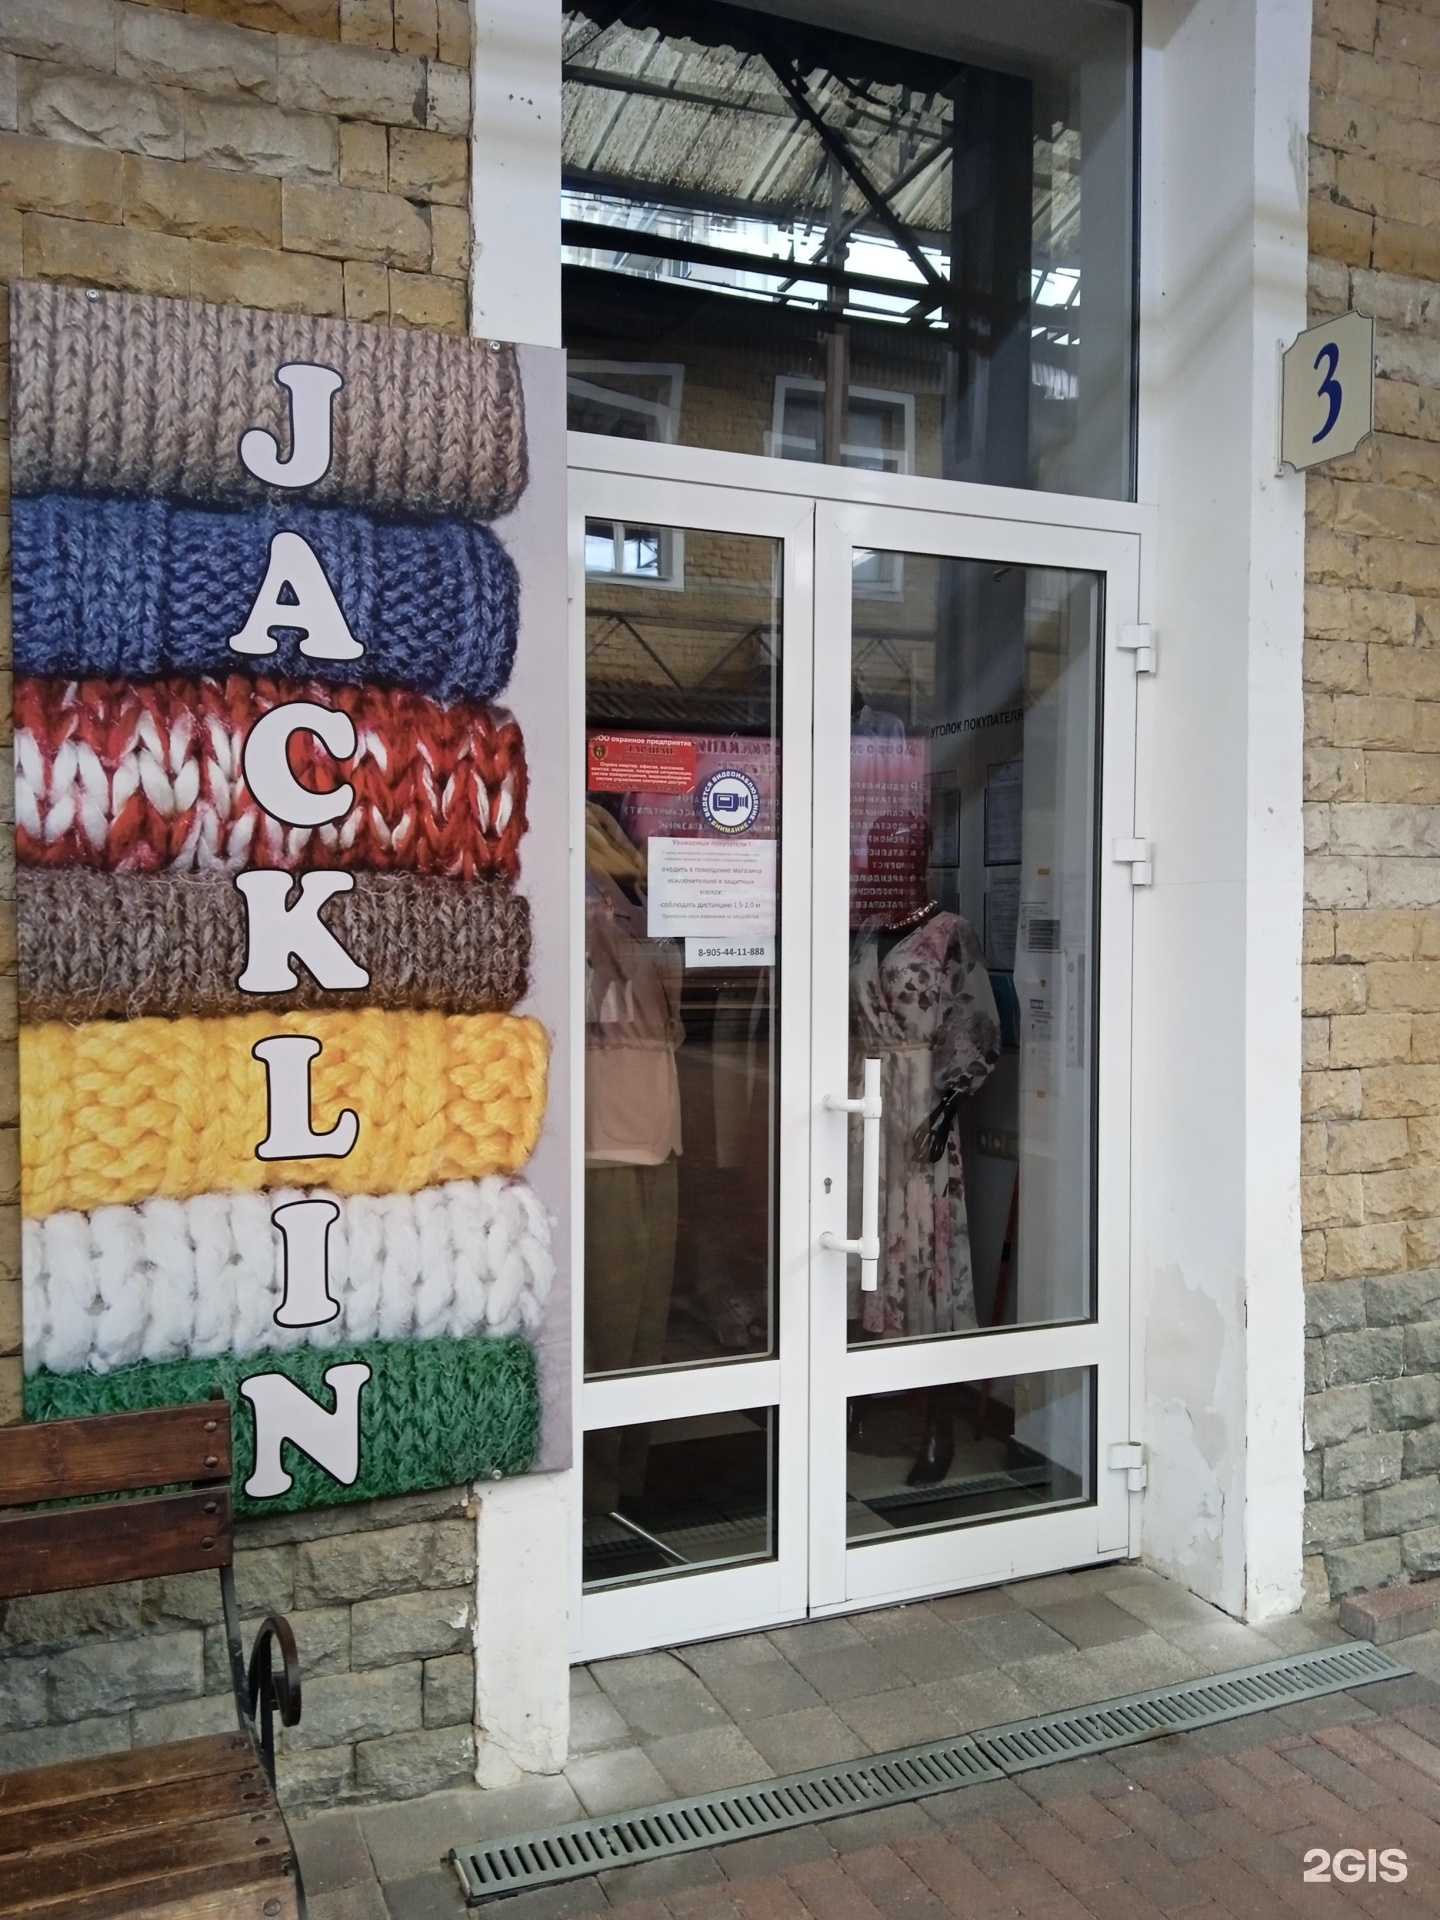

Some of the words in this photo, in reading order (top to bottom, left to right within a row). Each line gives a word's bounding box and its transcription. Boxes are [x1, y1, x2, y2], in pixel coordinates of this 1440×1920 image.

[1311, 342, 1343, 444] 3
[227, 362, 372, 1499] JACKLIN
[698, 947, 765, 957] 8-905-44-11-888
